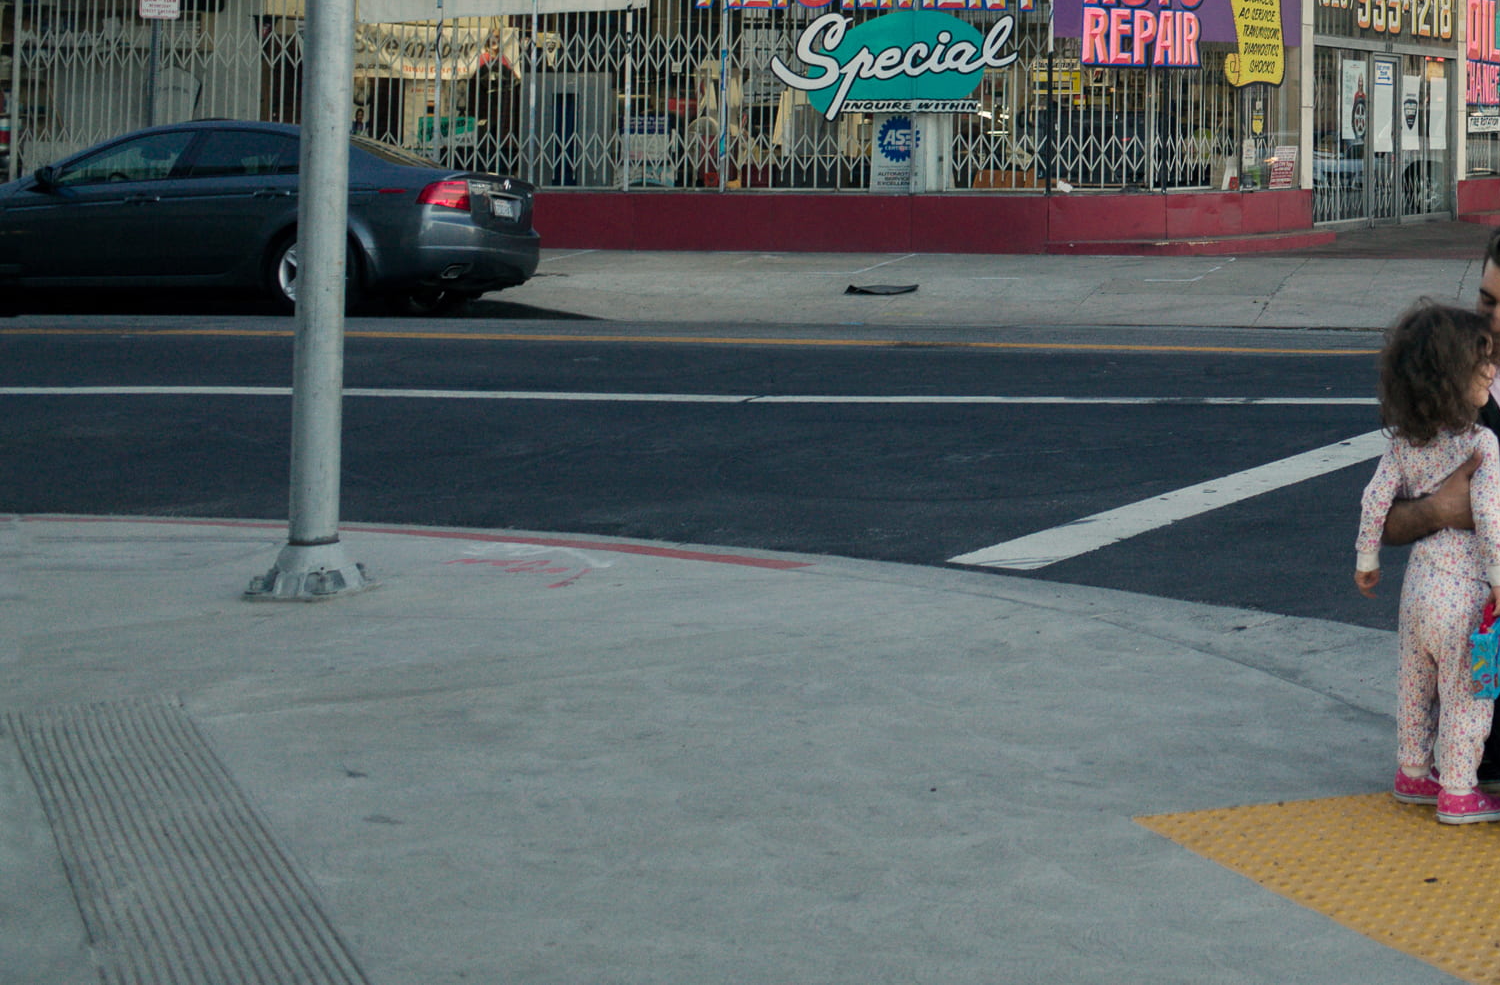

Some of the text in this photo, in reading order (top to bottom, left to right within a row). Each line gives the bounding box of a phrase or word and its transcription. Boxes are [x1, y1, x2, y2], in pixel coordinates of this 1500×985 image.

[1239, 7, 1276, 22] AC SERVICE
[1081, 6, 1201, 67] REPAIR
[770, 12, 1019, 122] Special
[1249, 59, 1276, 74] SHOCKS
[844, 101, 979, 111] INQUIRE WITHIN
